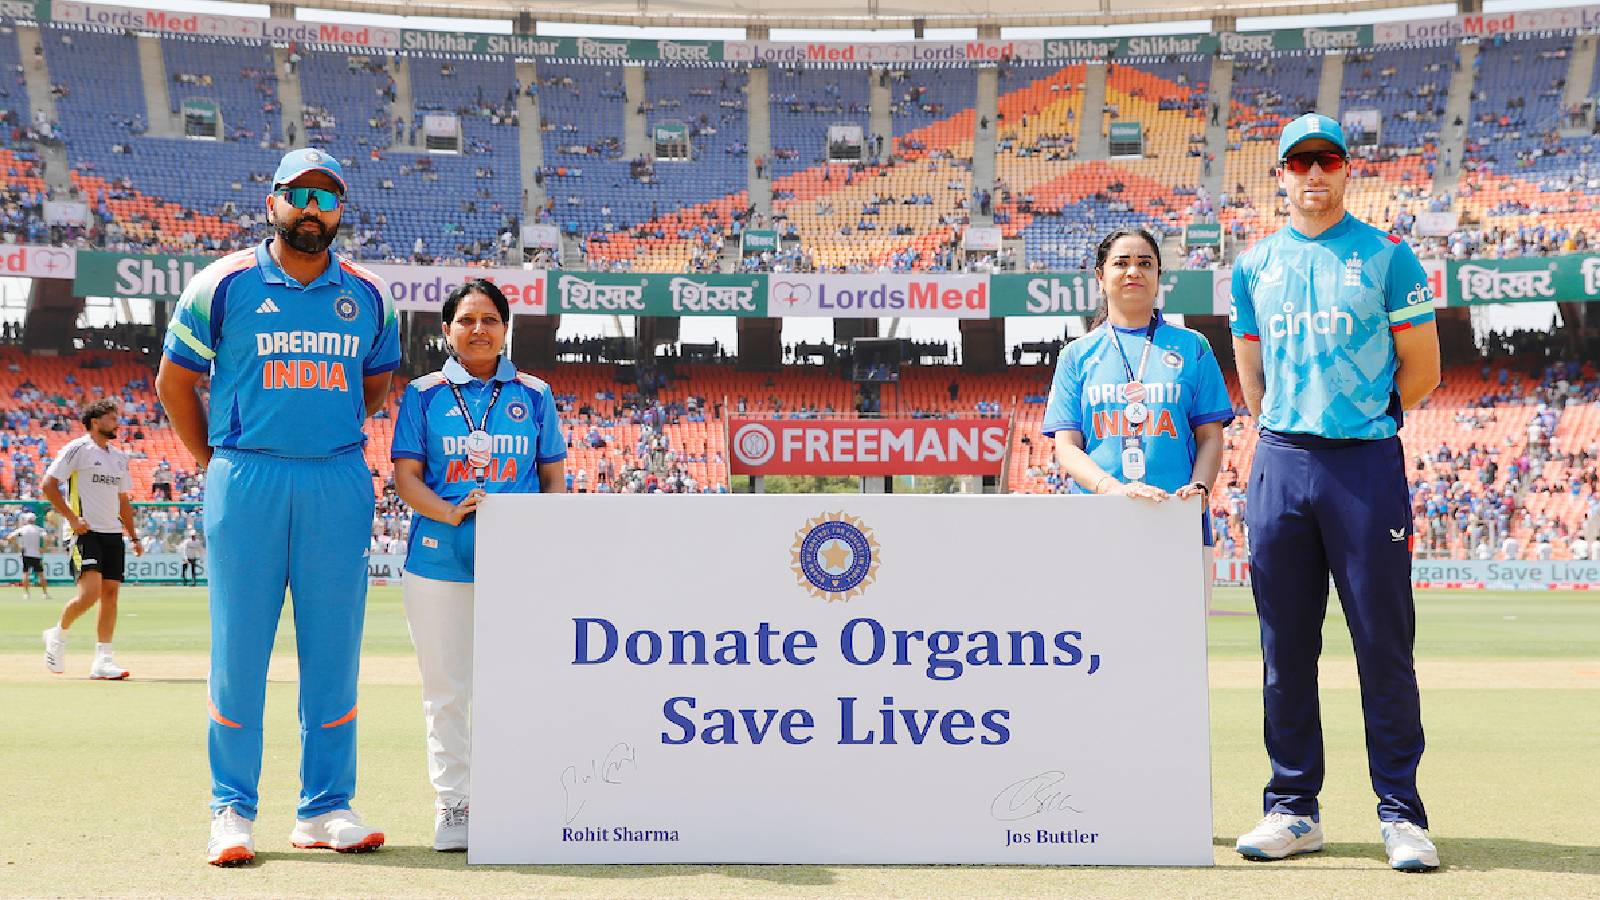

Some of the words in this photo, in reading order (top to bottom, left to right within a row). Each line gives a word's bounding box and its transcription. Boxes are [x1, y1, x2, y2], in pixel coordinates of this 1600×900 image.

[85, 6, 199, 32] LordsMed
[1405, 14, 1515, 39] LordsMed
[262, 22, 369, 45] LordsMed
[754, 43, 855, 62] LordsMed
[913, 42, 1014, 61] LordsMed
[817, 281, 987, 311] LordsMed
[1268, 300, 1354, 338] cinch
[262, 359, 349, 393] INDIA
[1087, 383, 1181, 407] DREM11
[782, 426, 1006, 462] FREEMANS
[1486, 563, 1542, 581] Save
[570, 617, 818, 667] Donate
[839, 616, 1102, 681] Organs,
[661, 696, 815, 745] Save
[837, 696, 1011, 745] Lives
[561, 826, 609, 842] Rohit
[613, 826, 680, 842] Sharma
[1005, 829, 1032, 847] Jos
[1036, 829, 1099, 844] Buttler
